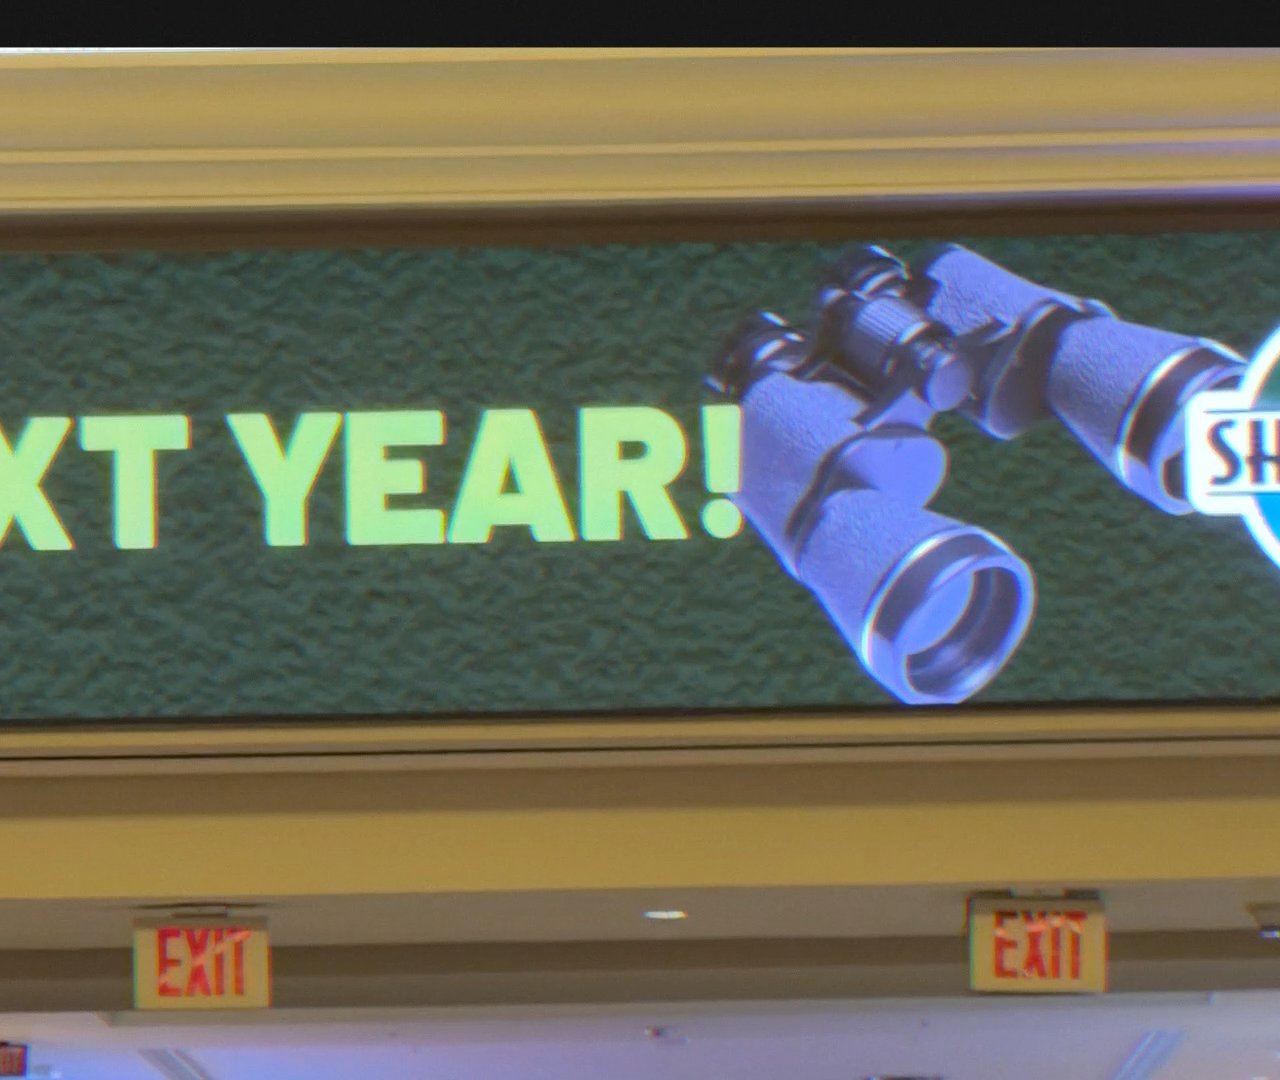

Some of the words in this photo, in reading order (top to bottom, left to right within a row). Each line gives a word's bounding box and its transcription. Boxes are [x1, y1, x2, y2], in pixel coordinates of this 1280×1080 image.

[226, 404, 743, 546] YEAR!
[156, 927, 252, 997] EXIT
[993, 910, 1088, 980] EXIT
